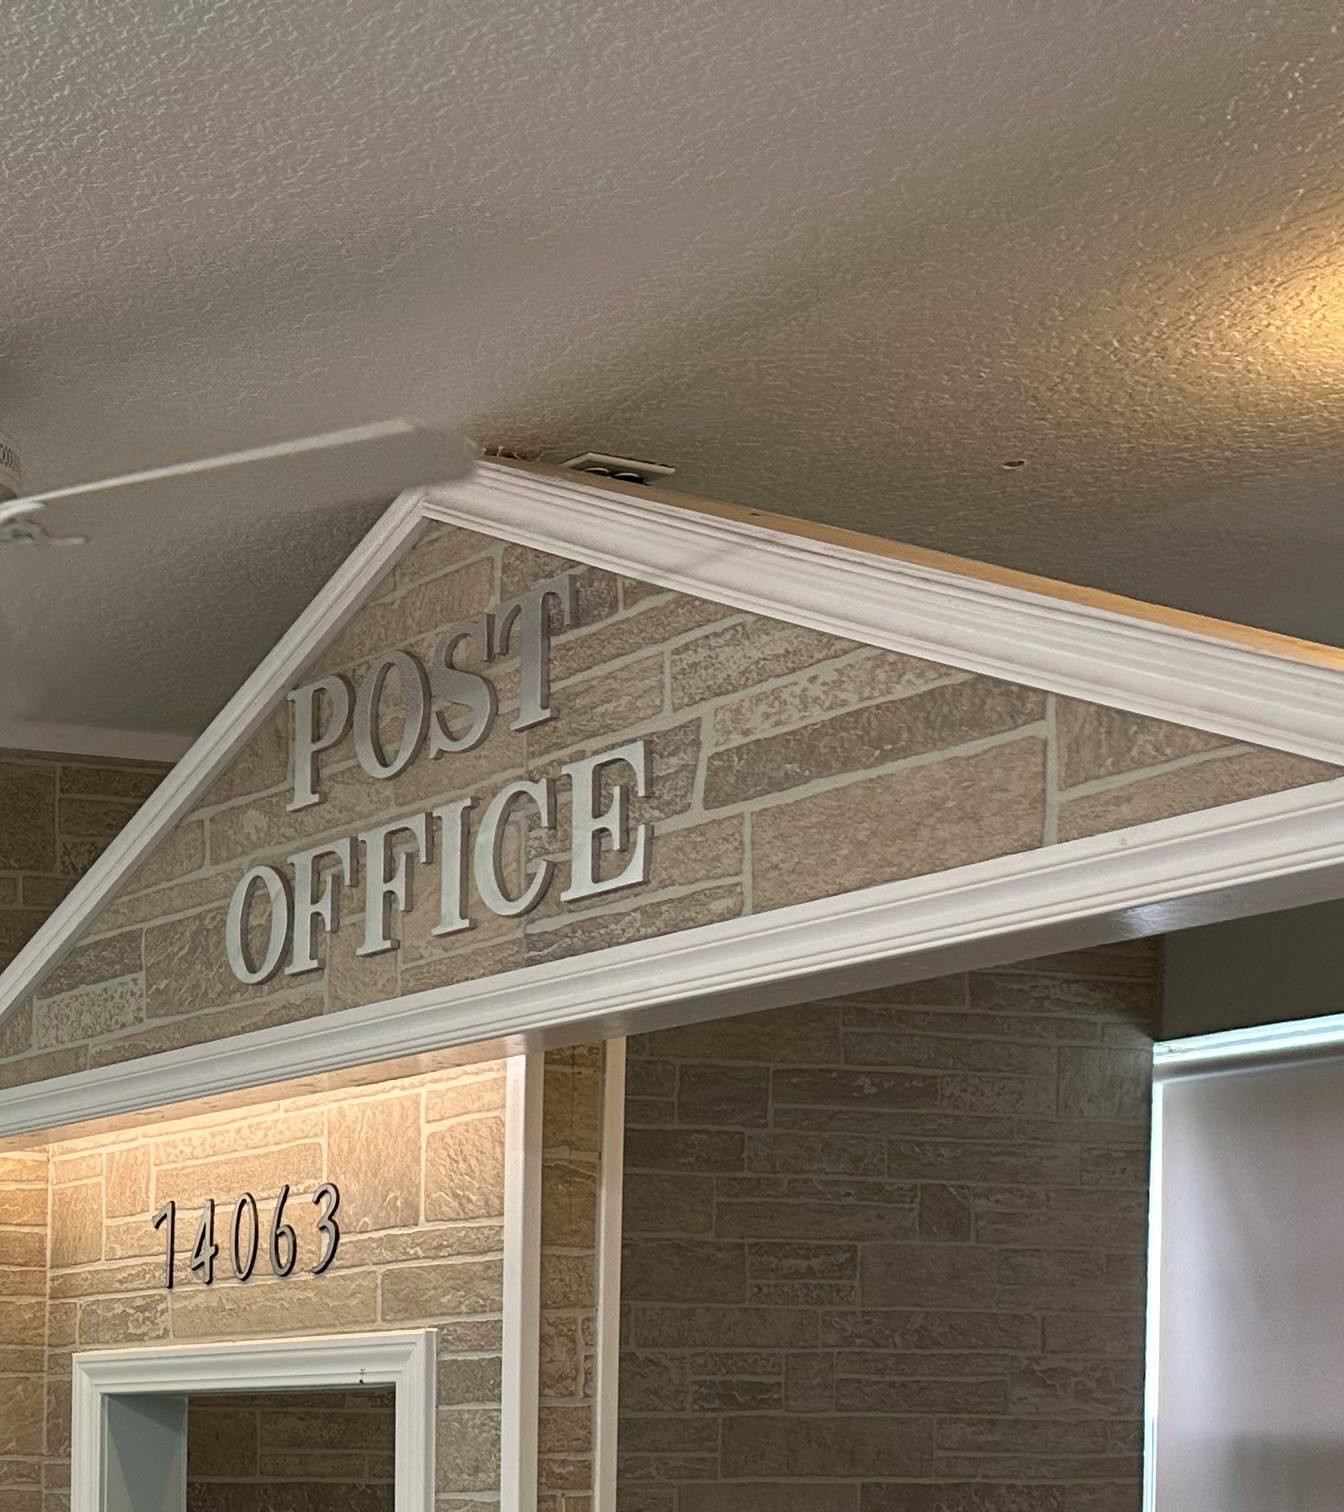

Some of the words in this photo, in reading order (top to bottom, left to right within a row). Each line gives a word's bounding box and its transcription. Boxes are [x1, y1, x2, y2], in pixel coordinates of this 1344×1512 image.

[286, 574, 578, 812] POST
[225, 740, 654, 985] OFFICE
[151, 1182, 341, 1290] 14063
